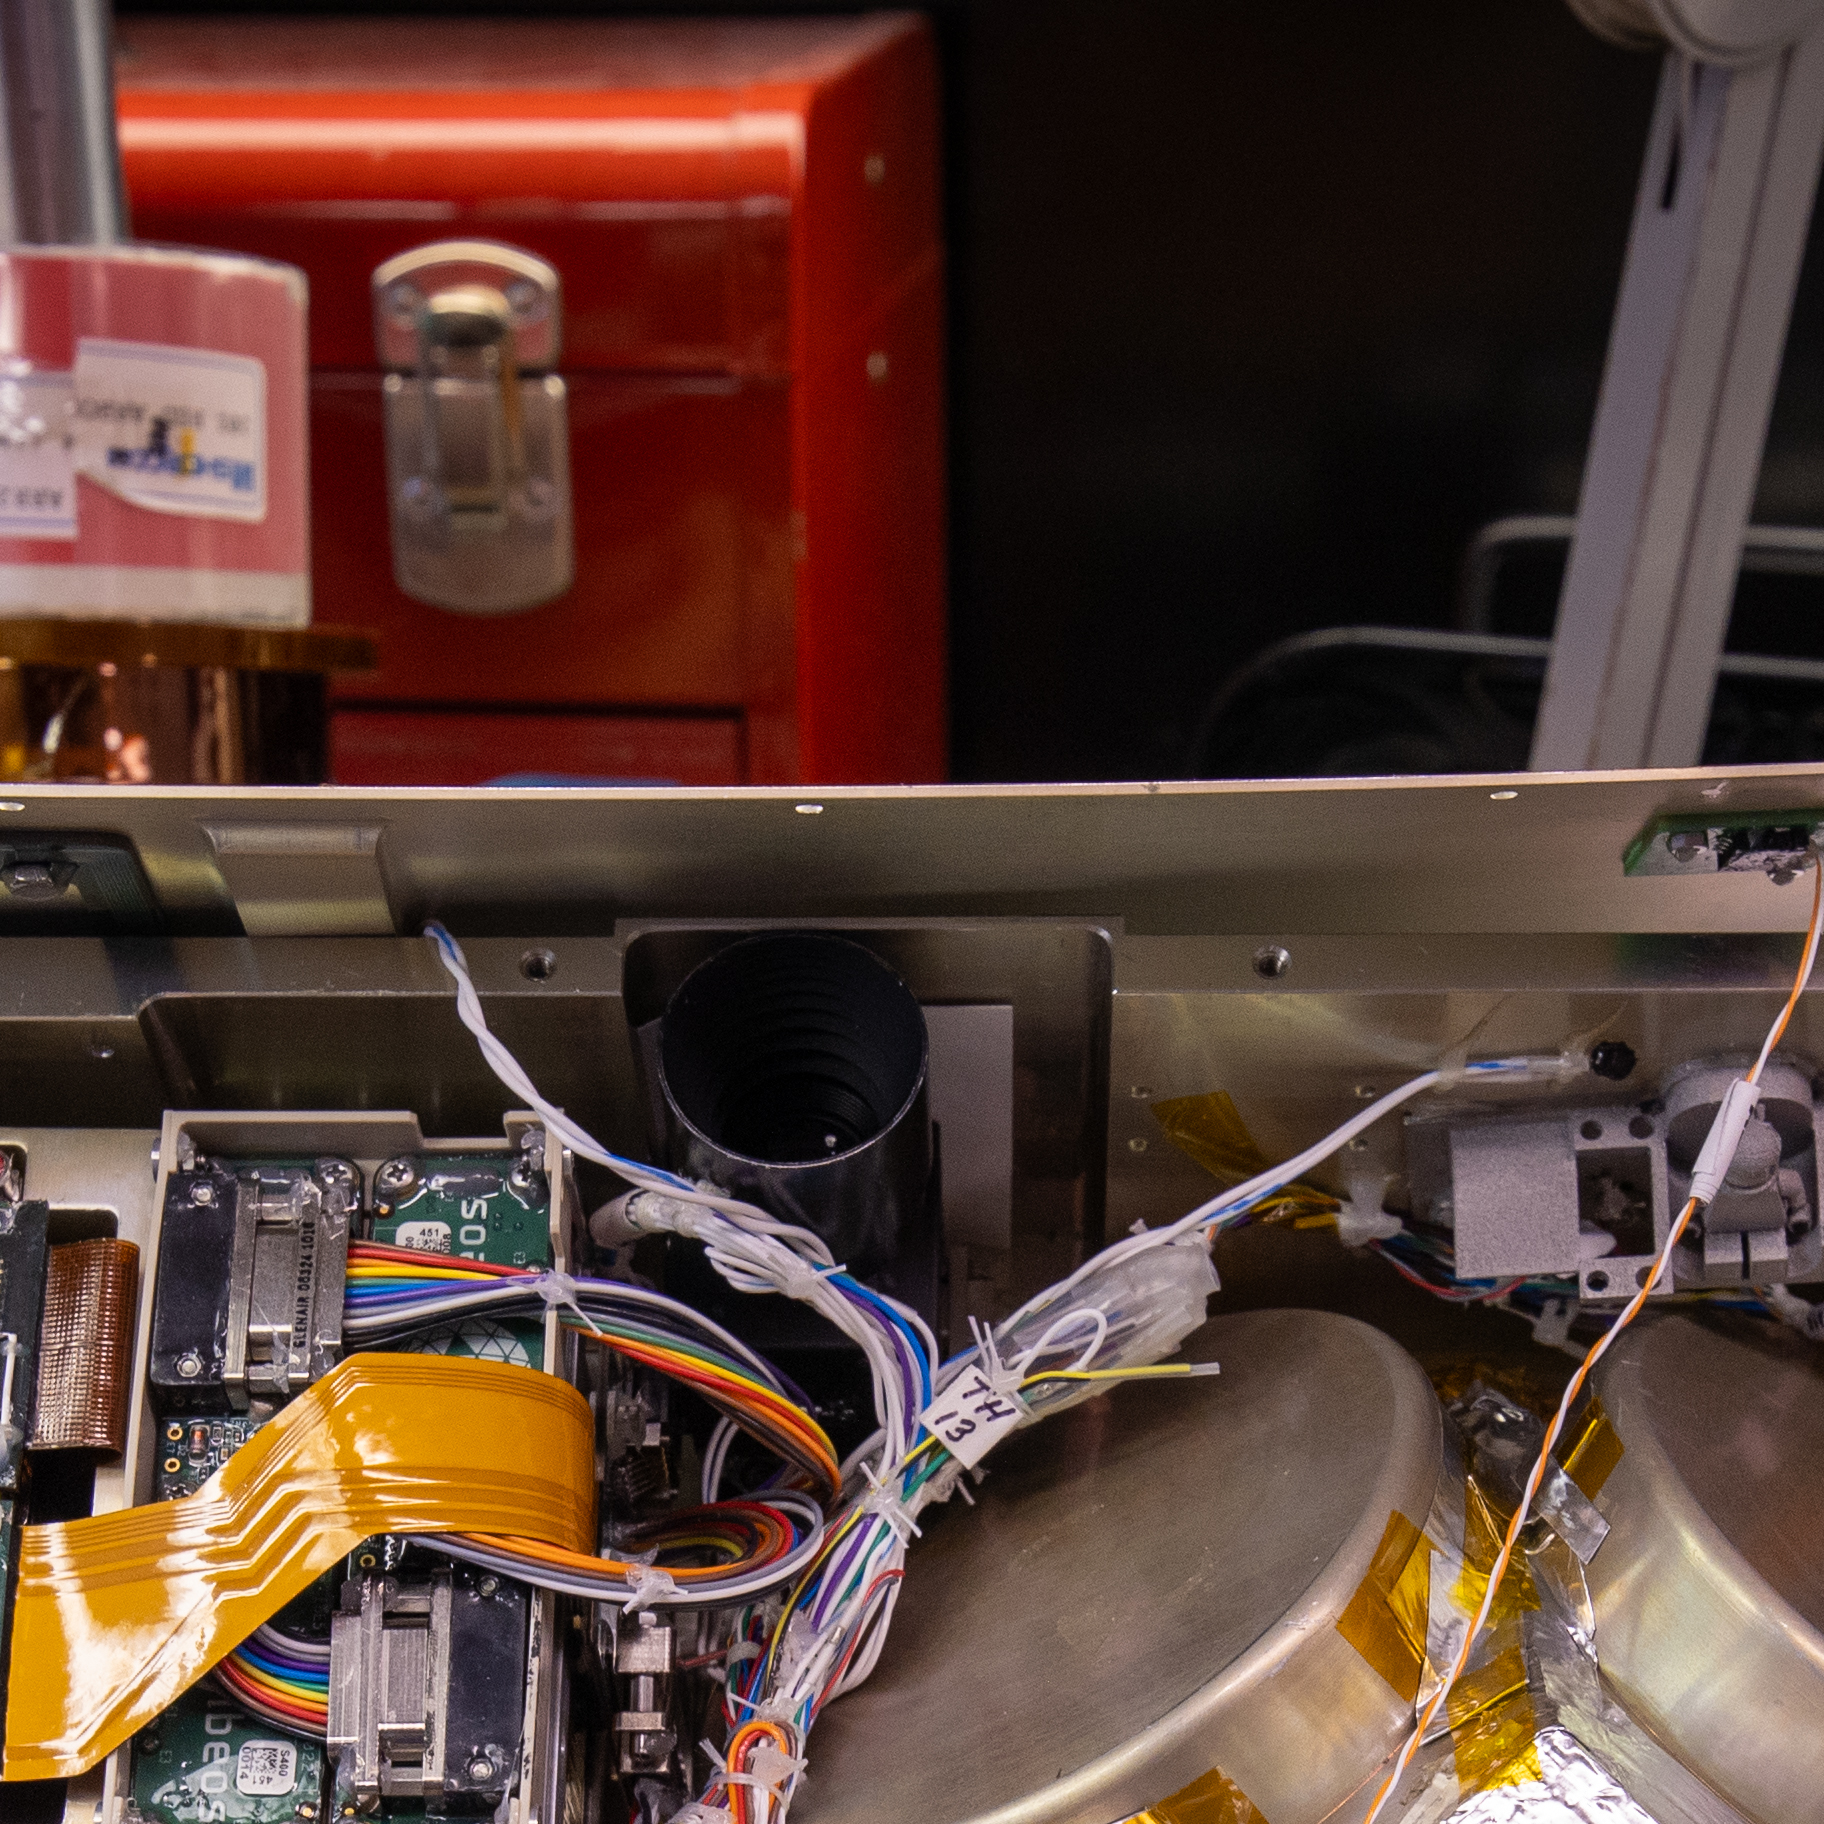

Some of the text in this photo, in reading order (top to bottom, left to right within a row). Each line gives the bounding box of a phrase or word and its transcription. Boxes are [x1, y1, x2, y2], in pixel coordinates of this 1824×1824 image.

[292, 1296, 309, 1348] GLENAIR
[961, 1375, 1017, 1424] TH
[933, 1410, 977, 1443] 13
